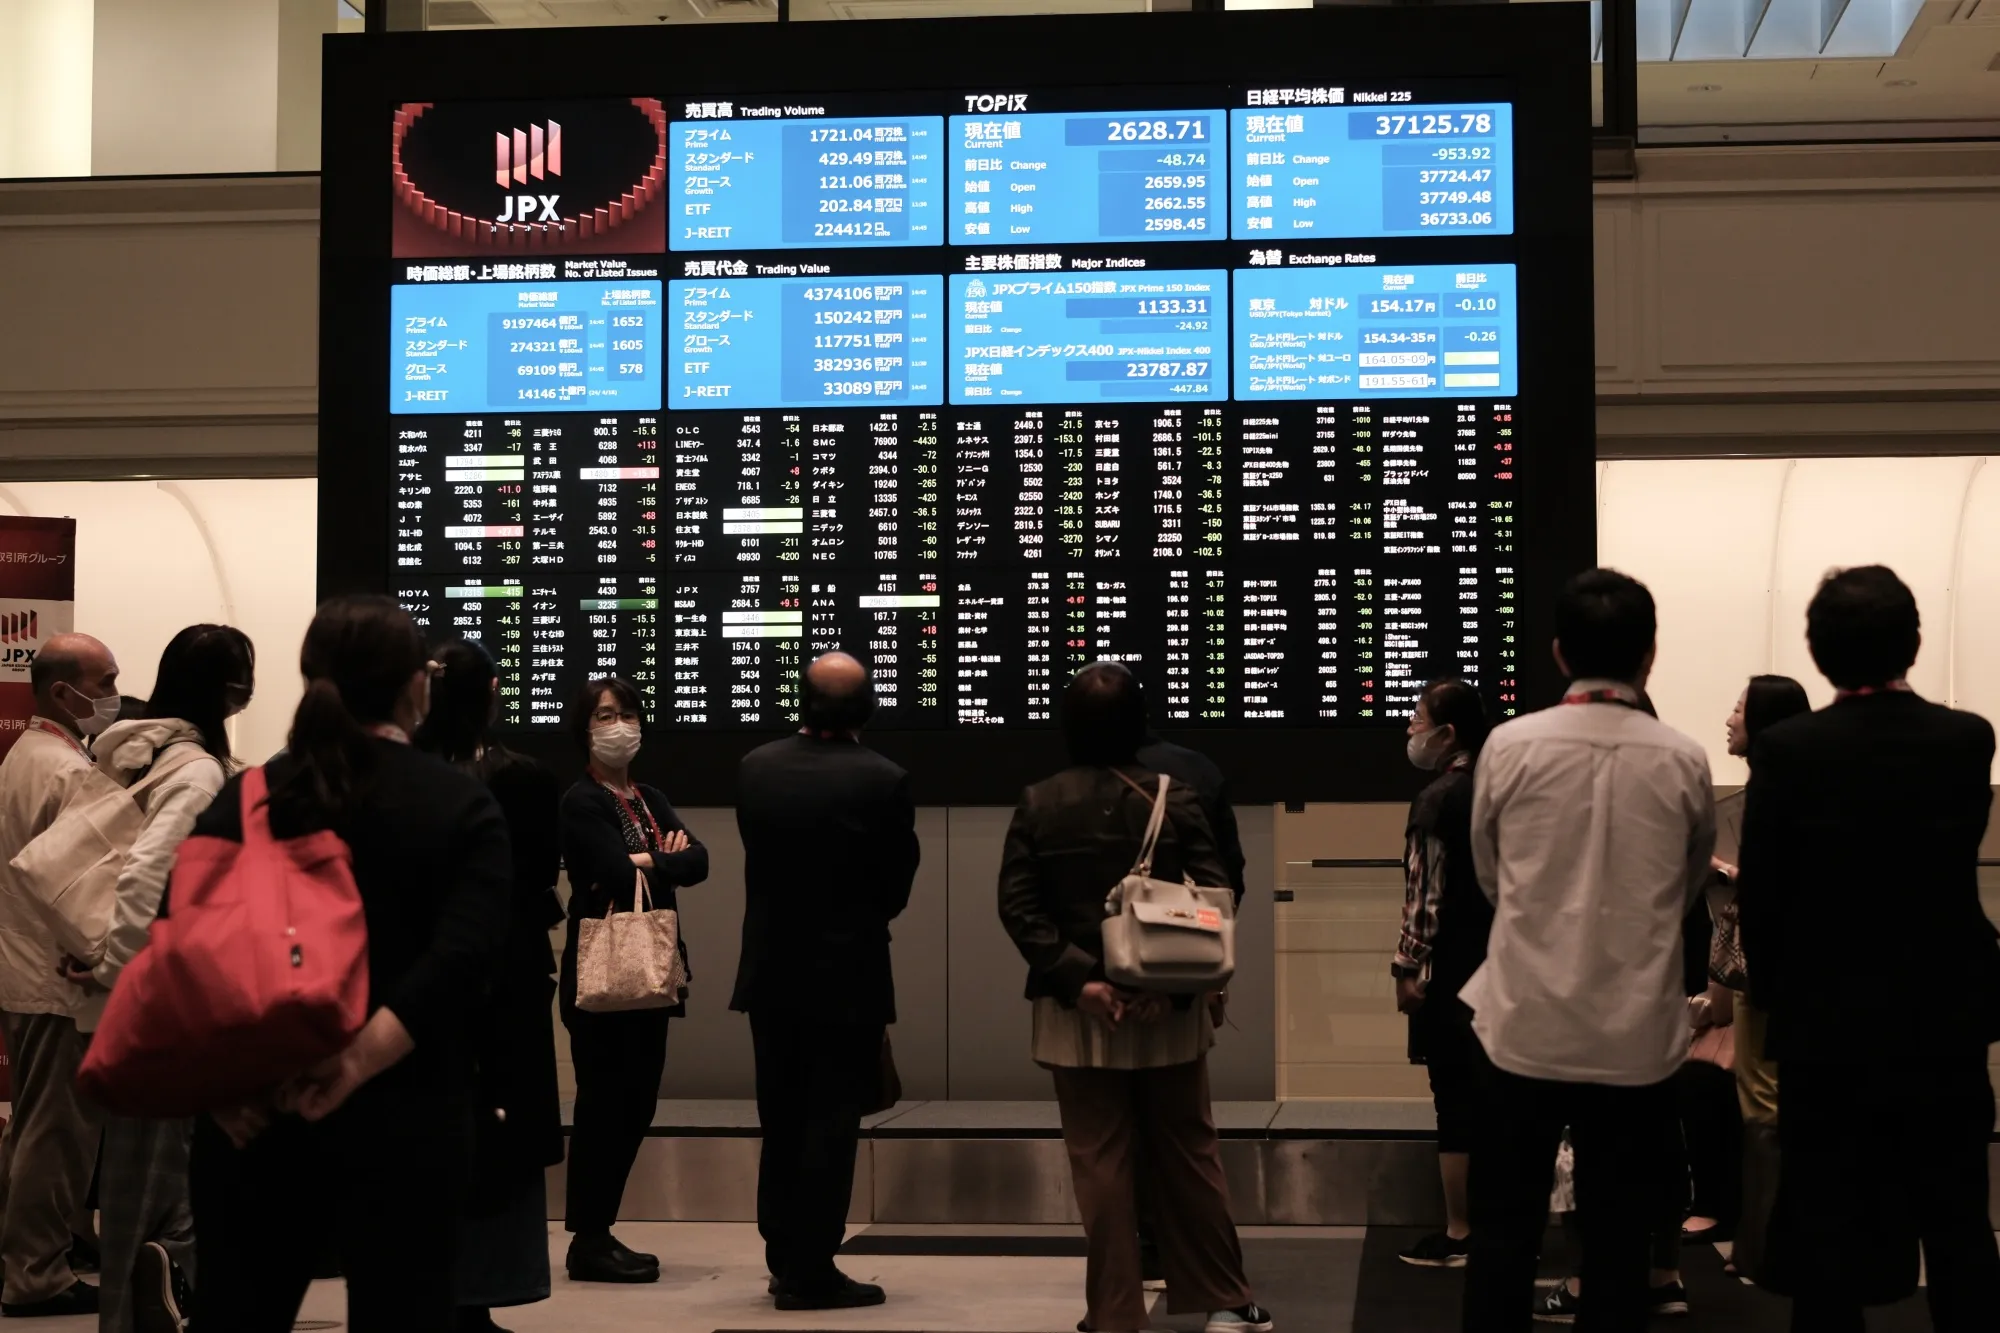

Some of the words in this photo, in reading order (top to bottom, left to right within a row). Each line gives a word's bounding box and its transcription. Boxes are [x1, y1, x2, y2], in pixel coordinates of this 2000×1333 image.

[1248, 88, 1344, 105] 日経平均株価
[1354, 92, 1387, 102] Nikkei
[1391, 92, 1411, 101] 225
[686, 102, 733, 118] 売買高
[740, 107, 781, 117] Trading
[784, 106, 824, 115] Volume
[965, 95, 1028, 112] TOPIX
[965, 121, 1021, 140] 現在値
[1108, 121, 1204, 140] 2628.71
[1247, 115, 1303, 134] 現在値
[1377, 114, 1490, 134] 37125.78
[686, 130, 731, 141] プライム
[810, 129, 872, 142] 1721.04
[1247, 134, 1285, 142] Current
[965, 140, 1002, 148] Current
[686, 152, 753, 165] スタンダード
[819, 152, 872, 165] 429.49
[965, 159, 1002, 171] 前日比
[1011, 161, 1046, 170] Change
[1157, 154, 1205, 165] -48.74
[1247, 153, 1285, 165] 前日比
[1293, 155, 1329, 165] Change
[1432, 148, 1490, 160] -953.92
[686, 176, 731, 188] グロース
[820, 176, 872, 188] 121.06
[965, 181, 990, 192] 始値
[1011, 184, 1035, 193] Open
[1145, 176, 1205, 188] 2659.95
[1247, 175, 1272, 186] 始値
[1293, 177, 1318, 187] Open
[1420, 170, 1491, 182] 37724.47
[685, 187, 713, 195] Growth
[965, 202, 990, 213] 高値
[1011, 204, 1032, 214] High
[1145, 197, 1205, 209] 2662.55
[1247, 196, 1272, 208] 高値
[1293, 198, 1316, 208] High
[1420, 191, 1491, 204] 37749.48
[496, 195, 560, 223] JPX
[686, 204, 710, 215] ETF
[820, 199, 872, 212] 202.84
[965, 223, 990, 234] 安値
[1011, 225, 1030, 233] Low
[1145, 218, 1205, 230] 2598.45
[1247, 217, 1272, 229] 安値
[1294, 220, 1313, 228] Low
[1421, 212, 1491, 225] 36733.06
[685, 227, 731, 238] J-REIT
[815, 223, 872, 236] 224412
[965, 254, 1062, 270] 主要株価指数
[1072, 259, 1103, 269] Major
[1106, 258, 1145, 267] Indices
[1249, 250, 1282, 265] 為替
[1289, 254, 1342, 265] Exchange
[1345, 254, 1376, 263] Rates
[565, 261, 598, 270] Market
[600, 260, 627, 269] Value
[685, 260, 748, 276] 売買代金
[756, 265, 796, 275] Trading
[800, 264, 830, 273] Value
[565, 269, 581, 277] No.
[584, 269, 593, 277] of
[595, 268, 624, 277] Listed
[626, 268, 657, 276] Issues
[1384, 275, 1414, 285] 現在値
[1456, 273, 1486, 284] 前日比
[685, 288, 730, 299] プライム
[804, 287, 872, 300] 4374106
[993, 281, 1116, 295] JPXプライム150指数
[1185, 283, 1210, 291] Index
[966, 301, 1002, 313] 現在値
[1139, 300, 1206, 313] 1133.31
[1250, 299, 1275, 311] 東京
[1310, 298, 1348, 310] 対ドル
[1372, 300, 1423, 312] 154.17
[1456, 298, 1496, 310] -0.10
[406, 317, 447, 328] プライム
[503, 319, 556, 329] 9197464
[613, 317, 643, 326] 1652
[685, 310, 753, 323] スタンダード
[815, 311, 872, 324] 150242
[1176, 321, 1207, 330] -24.92
[685, 335, 730, 346] グロース
[815, 335, 871, 347] 117751
[1250, 333, 1315, 342] ワールド円レート
[1365, 333, 1426, 343] 154.34-35
[1427, 334, 1435, 342] 円
[1465, 332, 1496, 341] -0.26
[511, 342, 556, 352] 274321
[613, 340, 642, 350] 1605
[965, 345, 1113, 358] JPX日経インデックス400
[685, 362, 709, 373] ETF
[814, 358, 872, 371] 382936
[1318, 354, 1351, 362] 対ユーロ
[1365, 355, 1426, 365] 164.05-09
[518, 365, 556, 375] 69109
[620, 364, 642, 373] 578
[965, 363, 1002, 376] 現在値
[1127, 363, 1207, 376] 23787.87
[1365, 376, 1426, 386] 191.55-61
[405, 391, 448, 401] J-REIT
[519, 389, 556, 399] 14146
[684, 386, 731, 397] J-REIT
[824, 382, 872, 395] 33089
[1170, 385, 1208, 393] -447.84
[742, 425, 760, 433] 4543
[874, 437, 897, 445] 76900
[914, 437, 936, 445] -4430
[1020, 463, 1043, 472] 12530
[1064, 463, 1082, 471] -230
[1097, 477, 1118, 485] トヨタ
[1163, 476, 1181, 484] 3524
[1207, 476, 1221, 484] -78
[399, 487, 430, 495] キリンHD
[455, 486, 482, 494] 2220.0
[498, 485, 521, 493] +11.0
[533, 513, 563, 521] エーザイ
[598, 512, 616, 520] 5892
[1095, 520, 1120, 528] SUBARU
[1163, 519, 1181, 527] 3311
[1203, 519, 1222, 527] -150
[874, 612, 896, 620] 167.7
[918, 612, 935, 620] -2.1
[878, 626, 896, 634] 4252
[923, 626, 936, 634] +18
[2, 649, 36, 662] JPX
